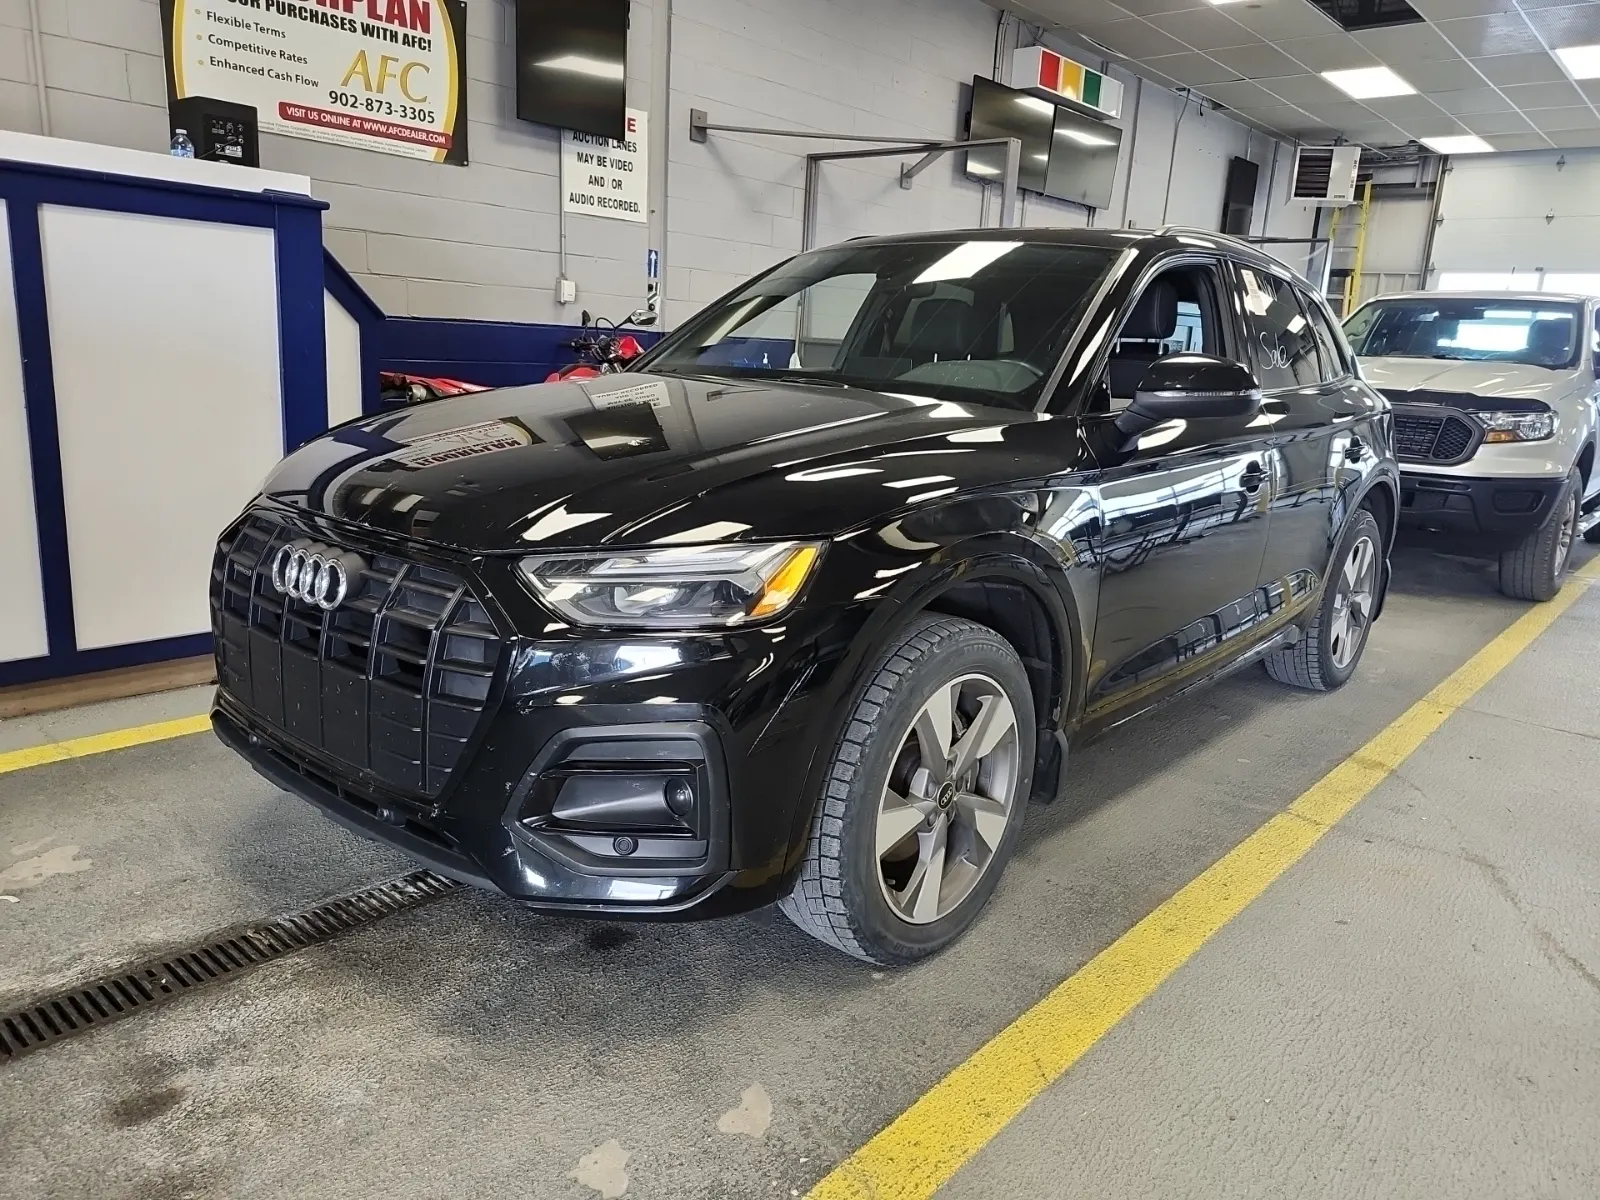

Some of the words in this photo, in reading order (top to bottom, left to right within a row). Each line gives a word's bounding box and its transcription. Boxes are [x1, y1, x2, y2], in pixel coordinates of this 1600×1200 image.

[206, 10, 252, 30] Flexible
[253, 22, 286, 39] Terms
[265, 0, 357, 33] PURCHASES
[360, 21, 399, 44] WITH
[402, 33, 432, 52] AFC!
[208, 34, 277, 58] Competitive
[279, 49, 308, 65] Rates
[209, 56, 265, 76] Enhanced
[267, 68, 293, 82] Cash
[295, 74, 319, 88] Flow
[341, 49, 430, 104] AFC
[329, 90, 436, 124] 902-873-3305
[286, 105, 306, 118] VISIT
[308, 109, 319, 121] US
[321, 112, 351, 127] ONLINE
[352, 117, 362, 128] AT
[363, 121, 446, 145] WWW.AFCDEALER.COM
[572, 131, 609, 148] AUCTION
[612, 139, 637, 153] LANES
[577, 151, 594, 165] MAY
[597, 155, 607, 168] BE
[609, 157, 634, 172] VIDEO
[588, 174, 605, 188] AND
[611, 178, 623, 190] OR
[569, 192, 595, 206] AUDIO
[597, 196, 641, 213] RECORDED.
